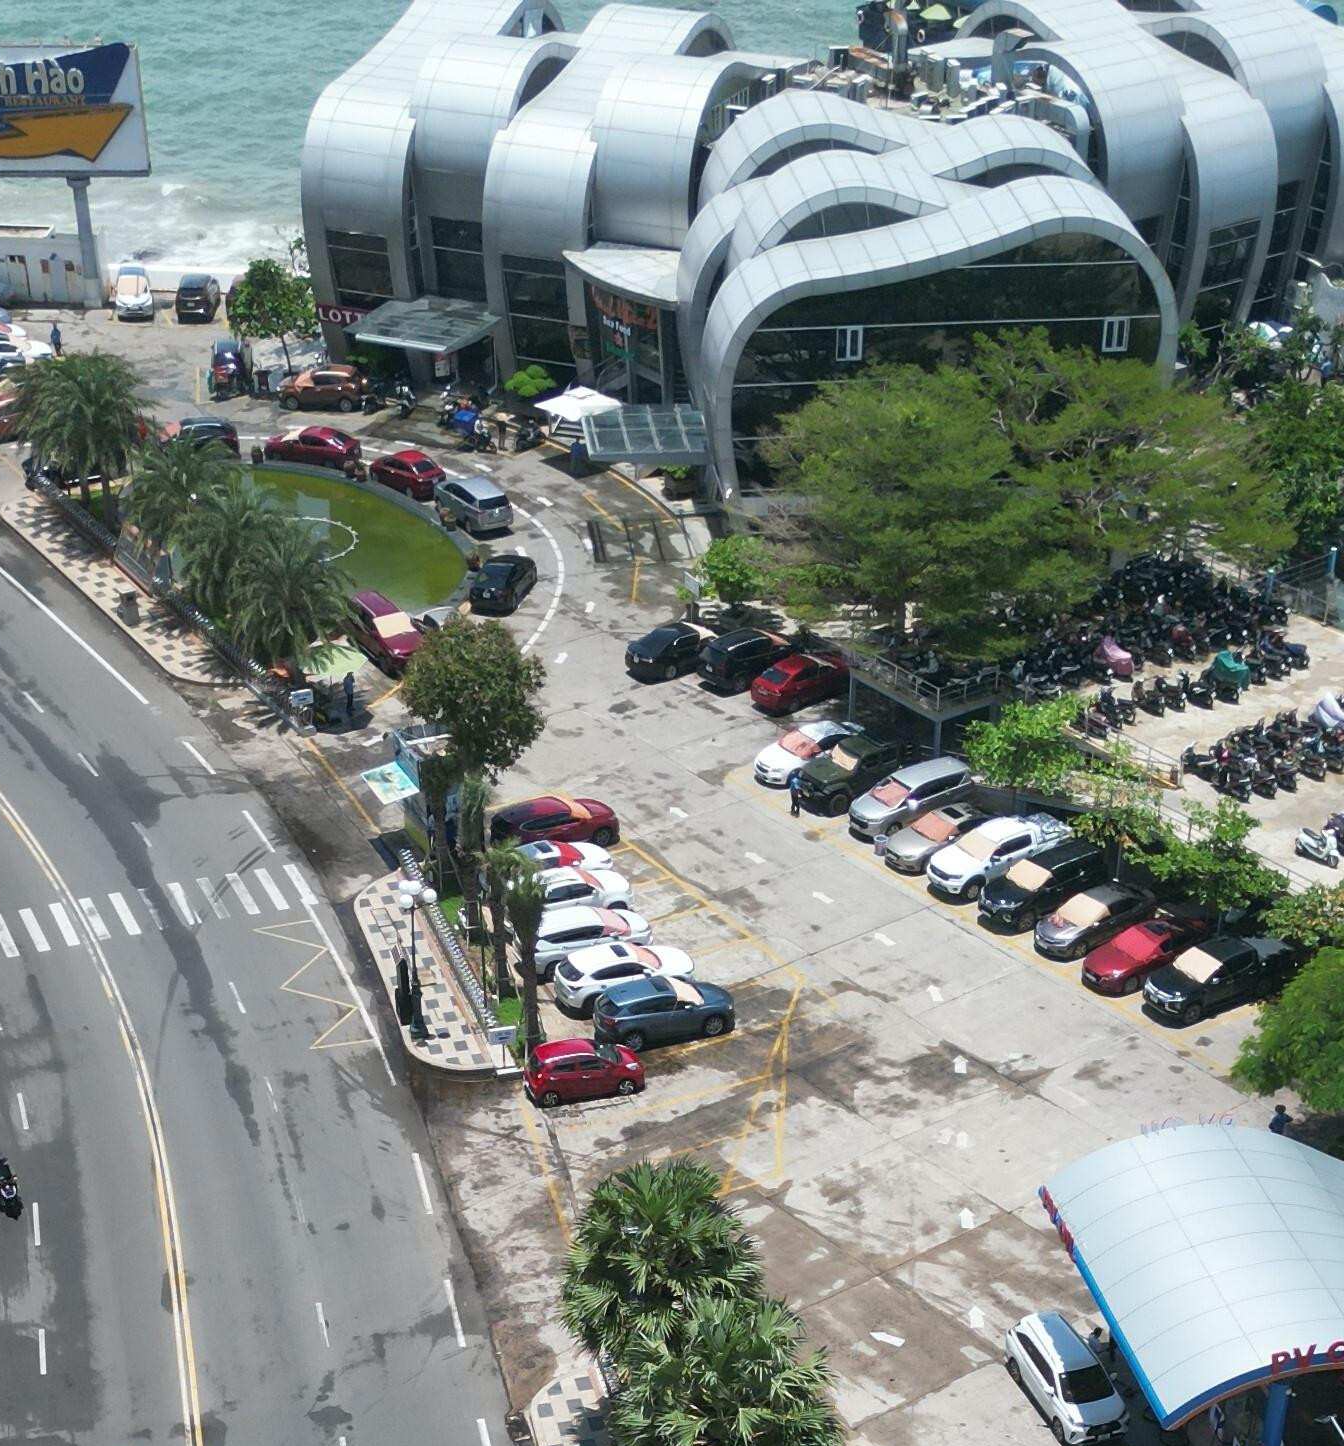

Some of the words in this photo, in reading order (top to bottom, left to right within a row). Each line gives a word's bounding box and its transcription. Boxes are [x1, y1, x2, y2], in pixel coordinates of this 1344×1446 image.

[25, 58, 85, 94] Hào
[318, 306, 367, 324] LOTT
[1271, 1344, 1317, 1378] PV
